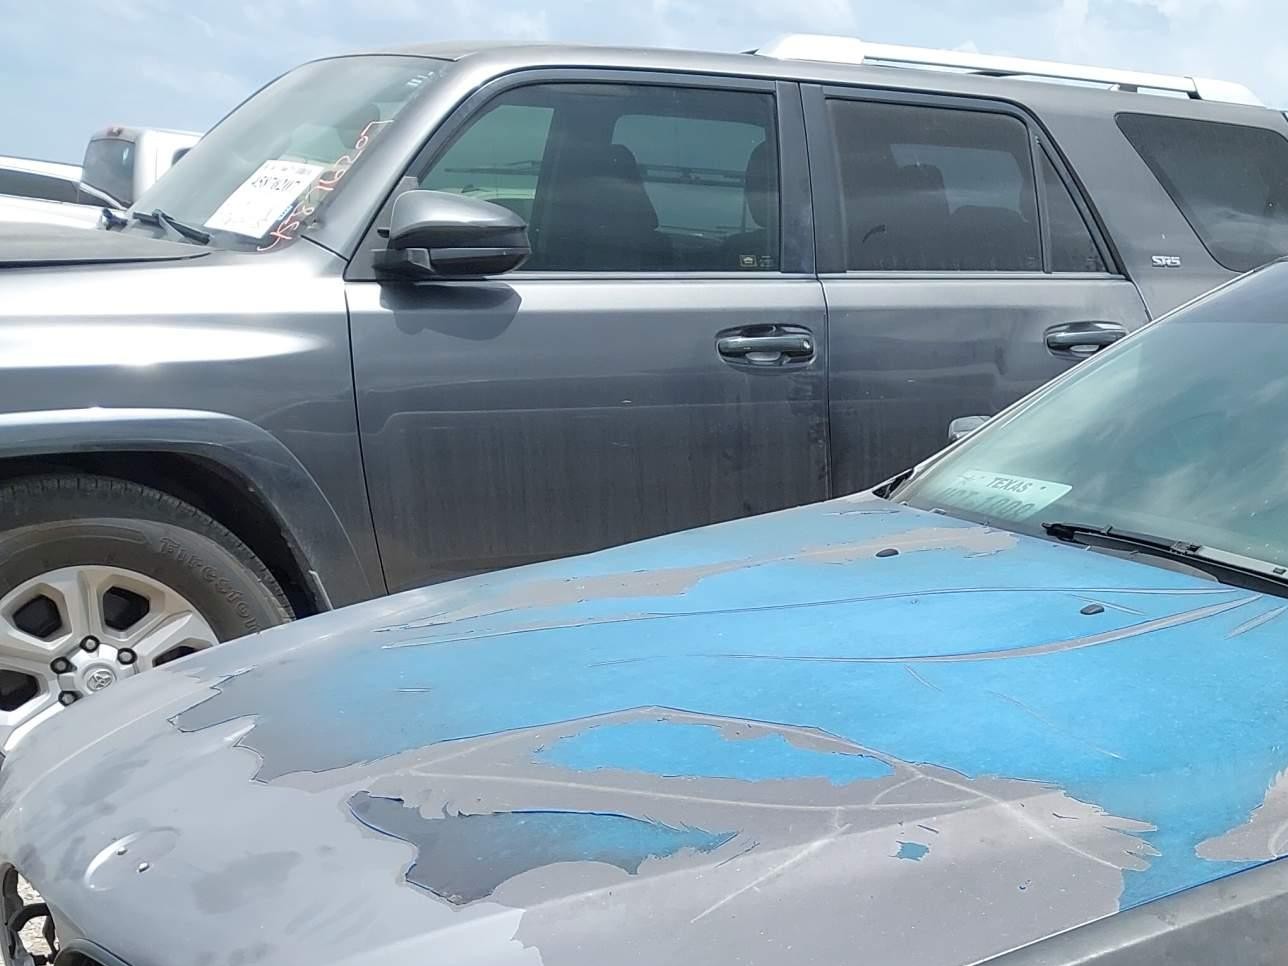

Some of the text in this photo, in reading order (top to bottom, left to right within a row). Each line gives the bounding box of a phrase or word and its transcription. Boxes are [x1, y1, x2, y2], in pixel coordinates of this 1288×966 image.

[1151, 255, 1181, 268] SR5
[985, 477, 1033, 493] TEXAS
[160, 537, 261, 633] Fireston
